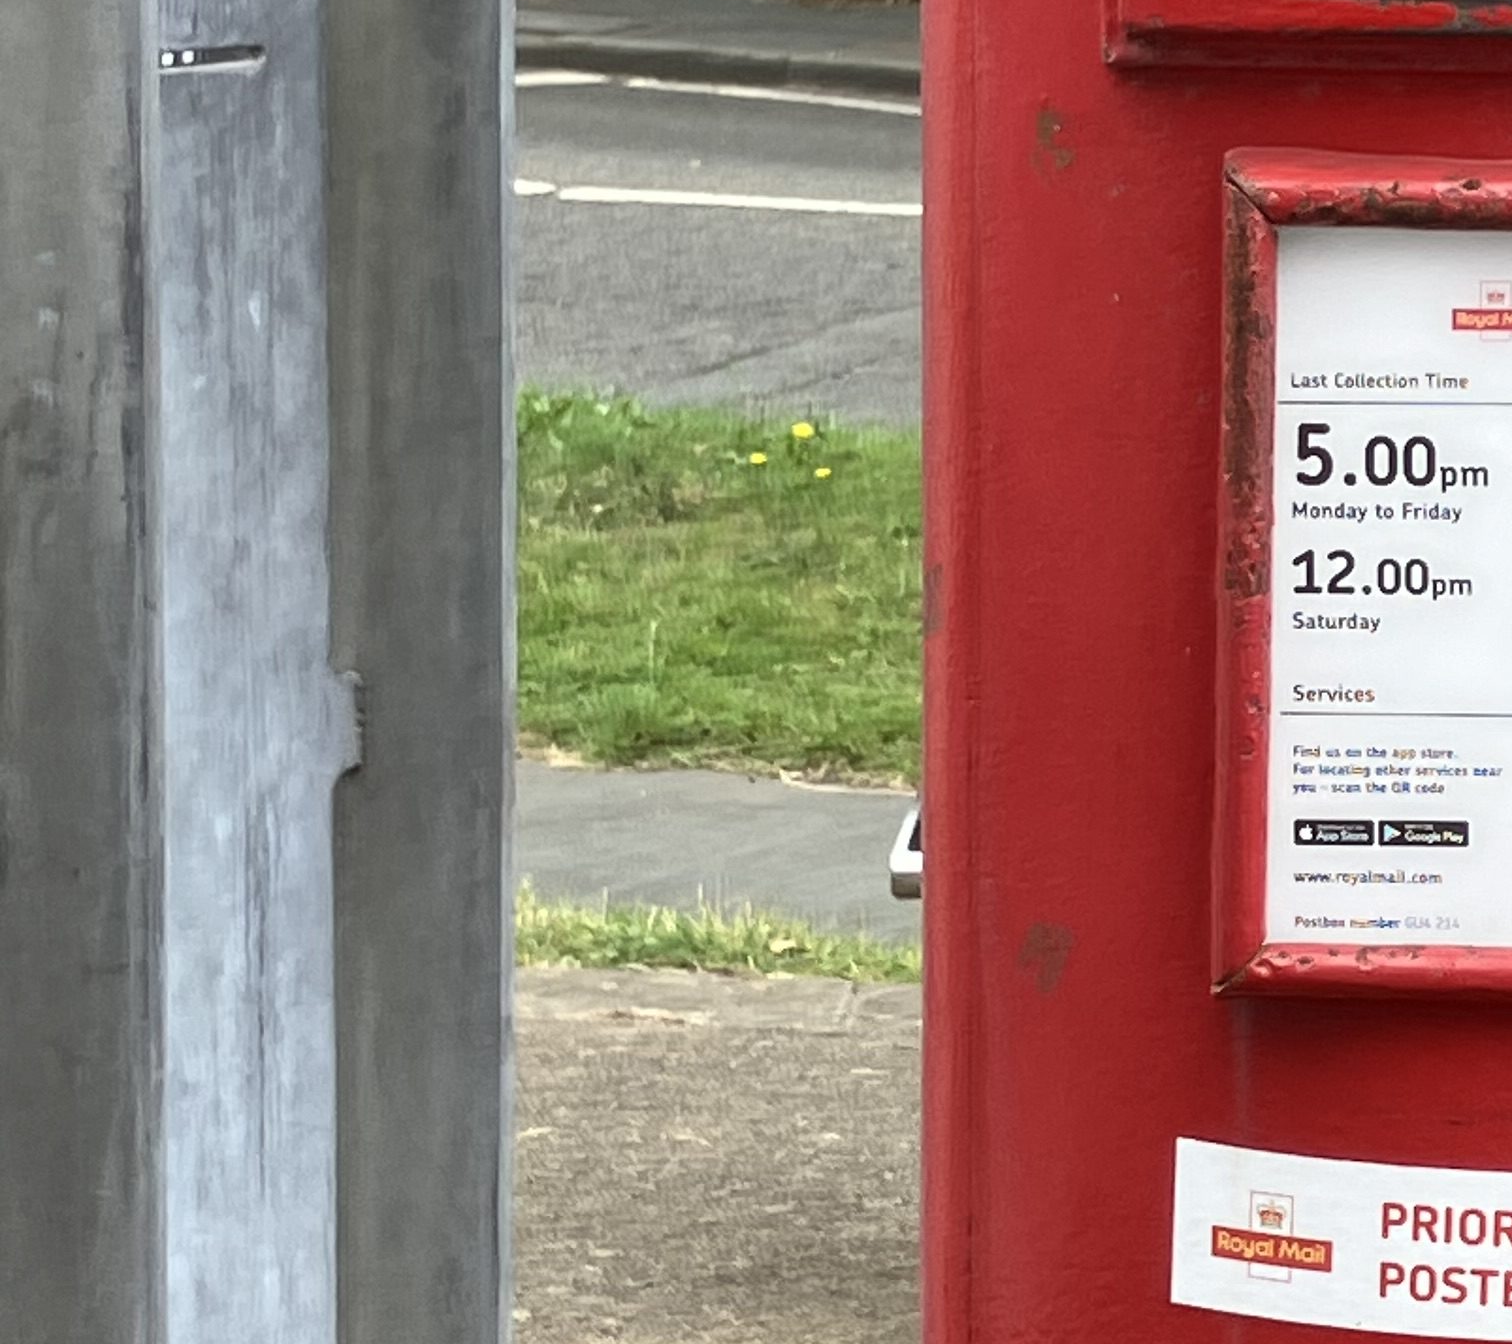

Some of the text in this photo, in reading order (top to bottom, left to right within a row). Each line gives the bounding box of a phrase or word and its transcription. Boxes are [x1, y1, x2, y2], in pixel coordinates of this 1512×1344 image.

[1455, 311, 1500, 328] Royal
[1291, 372, 1470, 389] Last Collection Time
[1296, 423, 1489, 493] 5.00pm
[1291, 502, 1462, 524] Monday to Friday
[1292, 549, 1473, 601] 12.00pm
[1292, 611, 1381, 633] Saturday
[1293, 684, 1376, 703] Services
[1292, 745, 1321, 758] Find
[1325, 749, 1341, 758] us
[1345, 749, 1362, 758] on
[1366, 746, 1387, 758] the
[1392, 749, 1417, 761] app
[1292, 763, 1503, 778] For locating other services near
[1292, 783, 1317, 795] you
[1331, 784, 1361, 794] scan
[1365, 781, 1387, 794] the
[1391, 781, 1411, 794] QR
[1415, 781, 1445, 794] code
[1316, 829, 1370, 842] App Store
[1404, 830, 1464, 844] Google Play
[1294, 869, 1443, 886] www.royalmail.com
[1294, 916, 1345, 929] Postbox
[1350, 916, 1401, 929] number
[1216, 1229, 1327, 1265] Royal Mail
